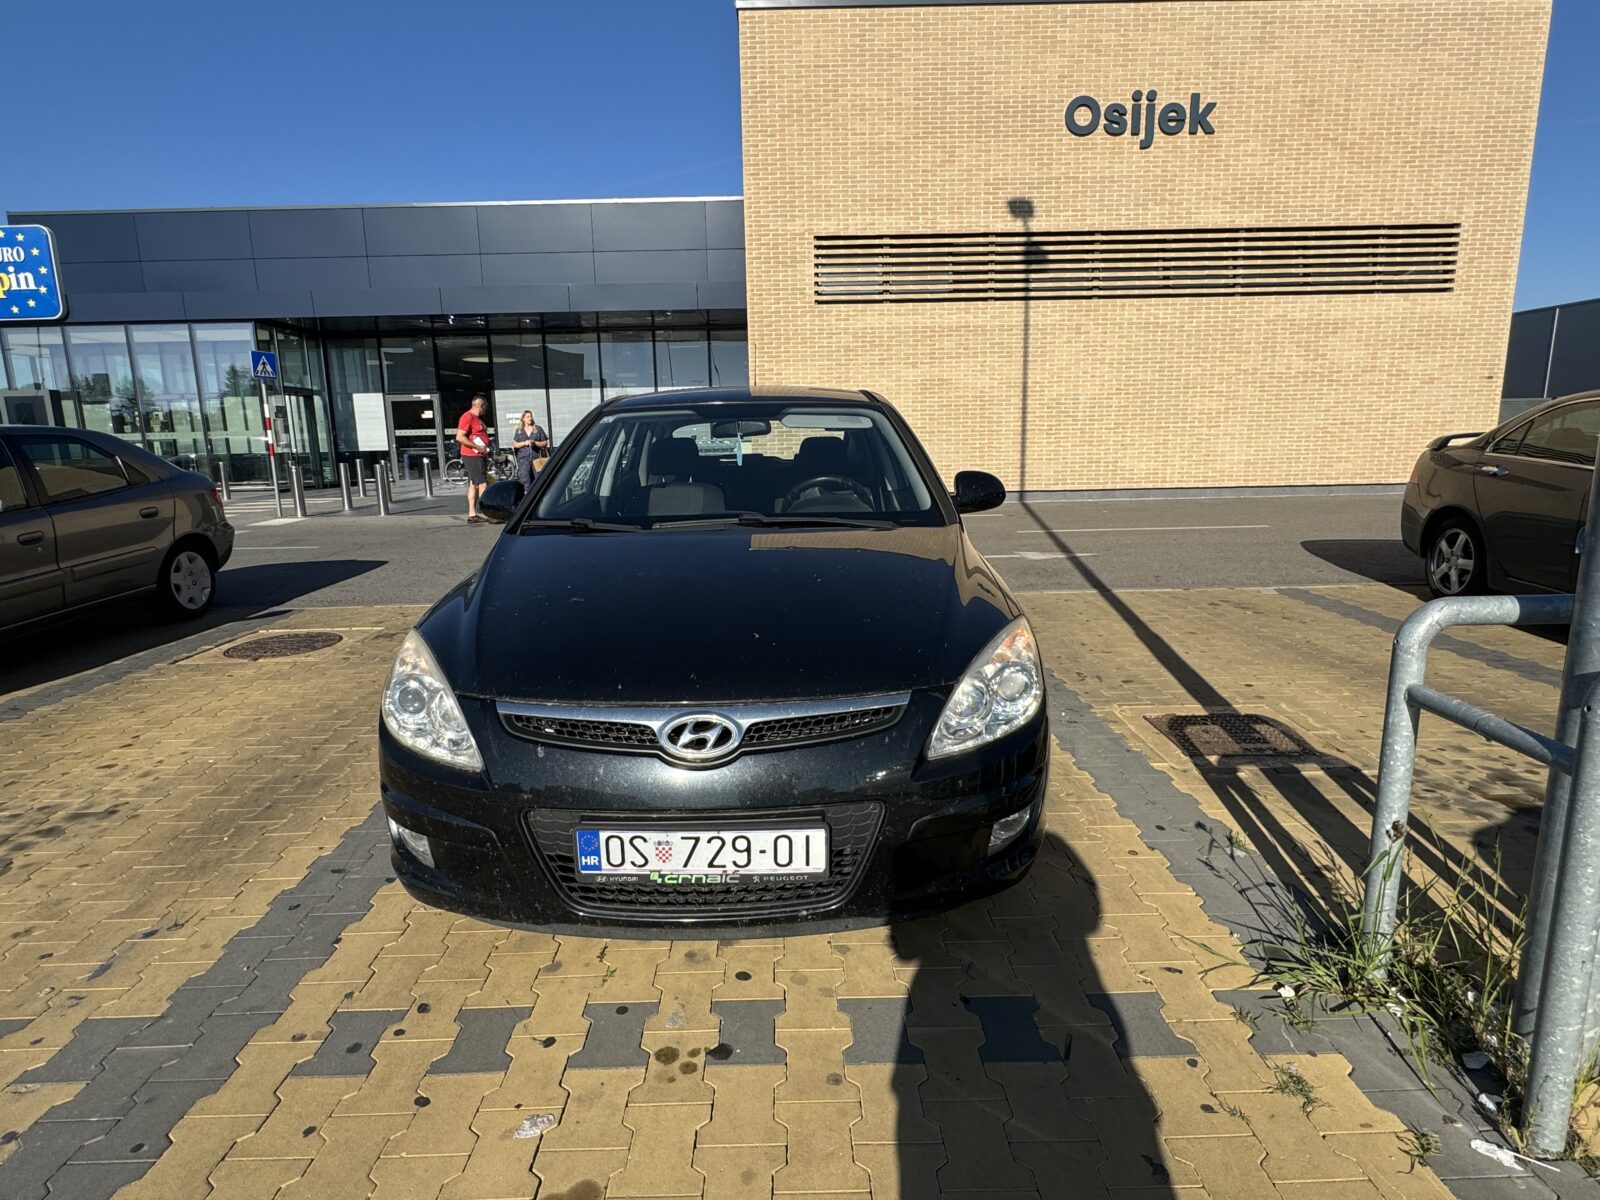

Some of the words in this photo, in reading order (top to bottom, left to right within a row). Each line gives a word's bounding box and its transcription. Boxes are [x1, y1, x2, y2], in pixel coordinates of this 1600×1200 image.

[1064, 89, 1217, 150] Osijek
[581, 855, 599, 866] HR
[605, 834, 649, 868] OS
